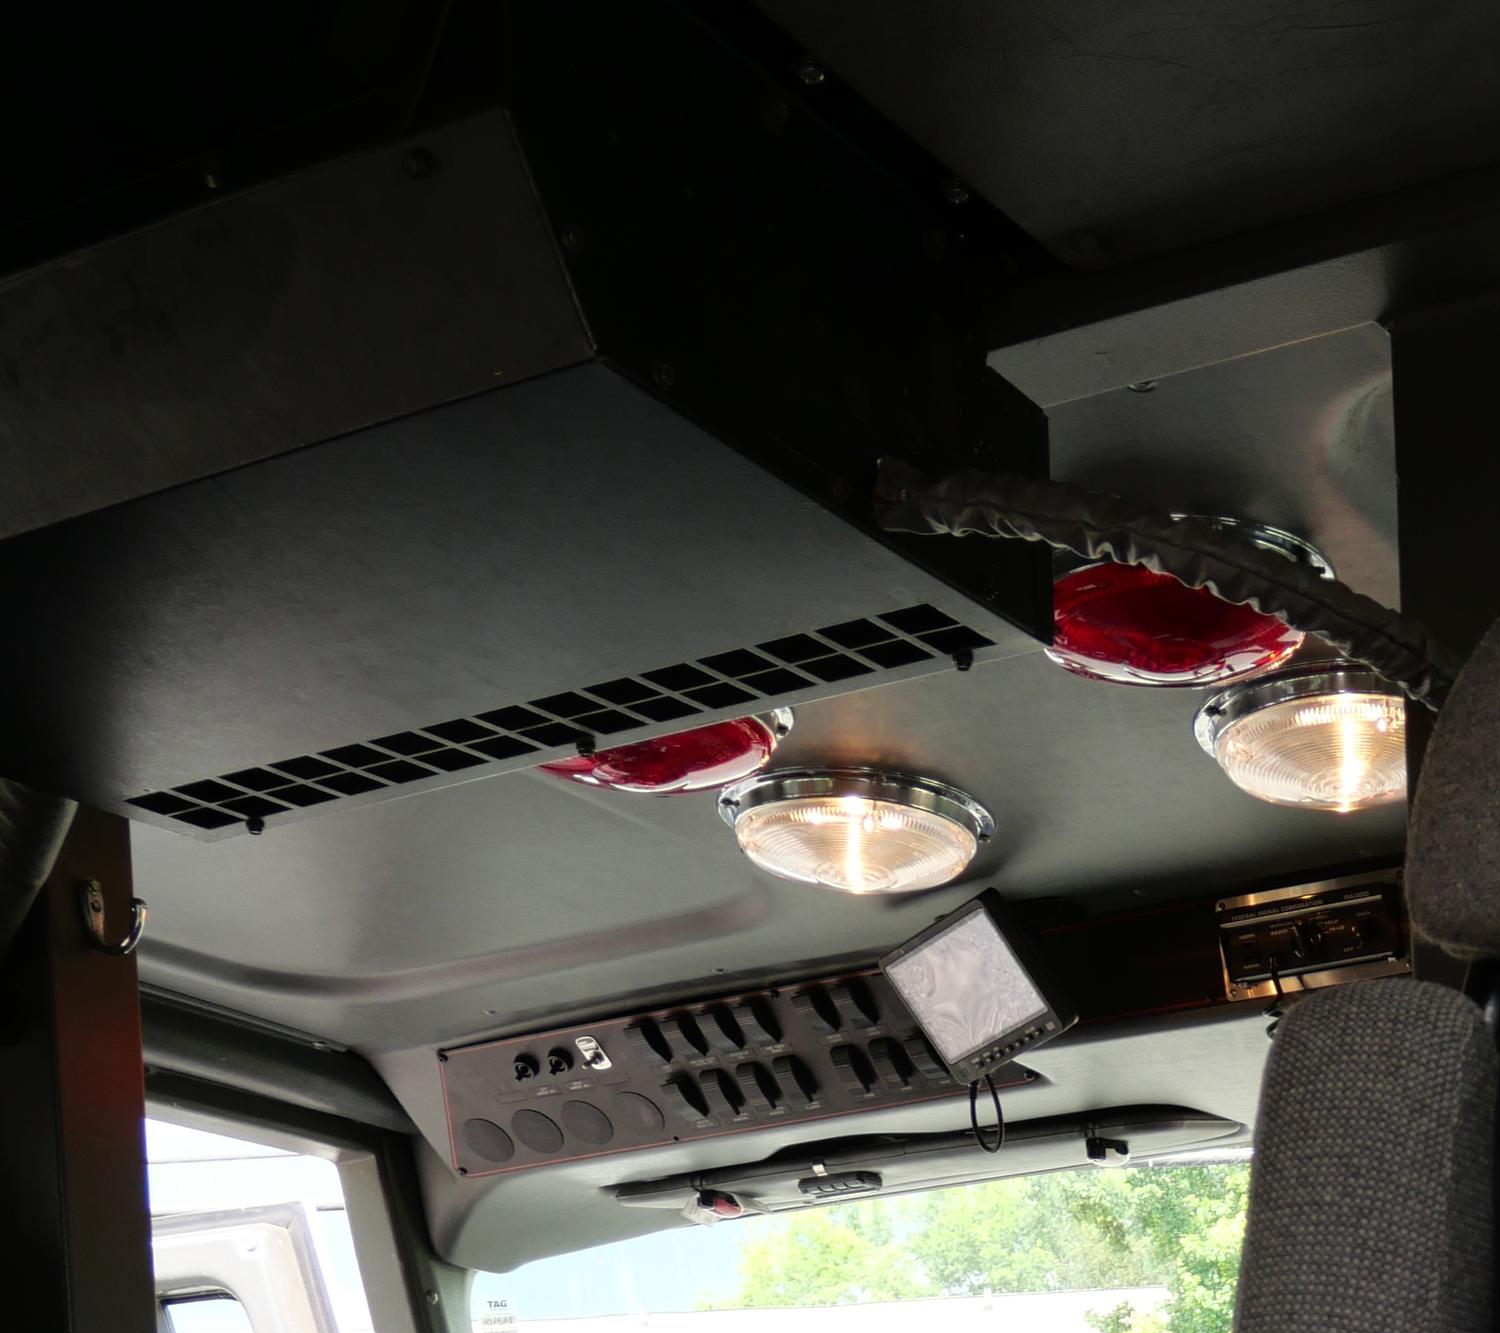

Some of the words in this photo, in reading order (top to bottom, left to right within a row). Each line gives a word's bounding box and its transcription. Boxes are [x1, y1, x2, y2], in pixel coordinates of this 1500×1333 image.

[1232, 912, 1256, 920] FEDERAL
[1258, 908, 1280, 917] SIGNAL
[1344, 891, 1369, 900] PA300
[486, 1299, 508, 1309] TAG
